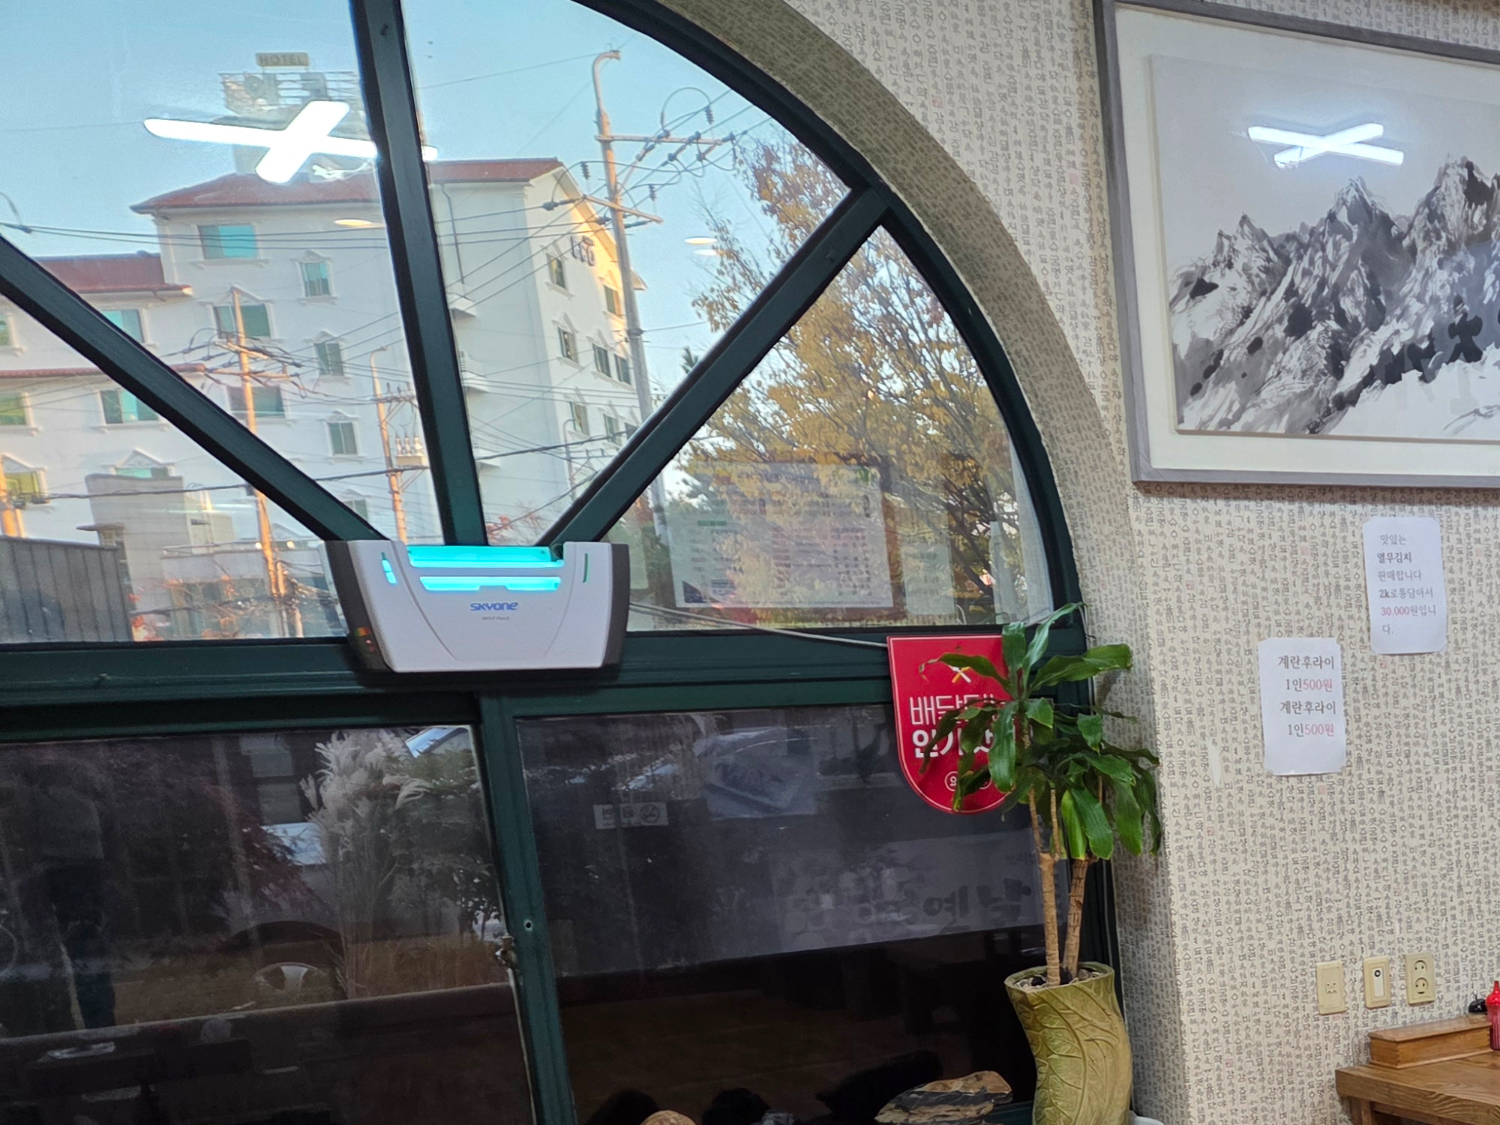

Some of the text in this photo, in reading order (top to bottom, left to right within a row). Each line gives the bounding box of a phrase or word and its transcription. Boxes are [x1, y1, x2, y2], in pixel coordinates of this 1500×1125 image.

[259, 54, 305, 66] HOTEL
[1380, 534, 1407, 545] 맛있는
[1377, 552, 1412, 563] 열무김치
[1378, 570, 1422, 581] 판매합니다
[1277, 656, 1335, 669] 계란후라이
[1286, 679, 1333, 692] 1인500원
[1280, 701, 1336, 715] 계란후라이
[1287, 724, 1335, 736] 1인500원
